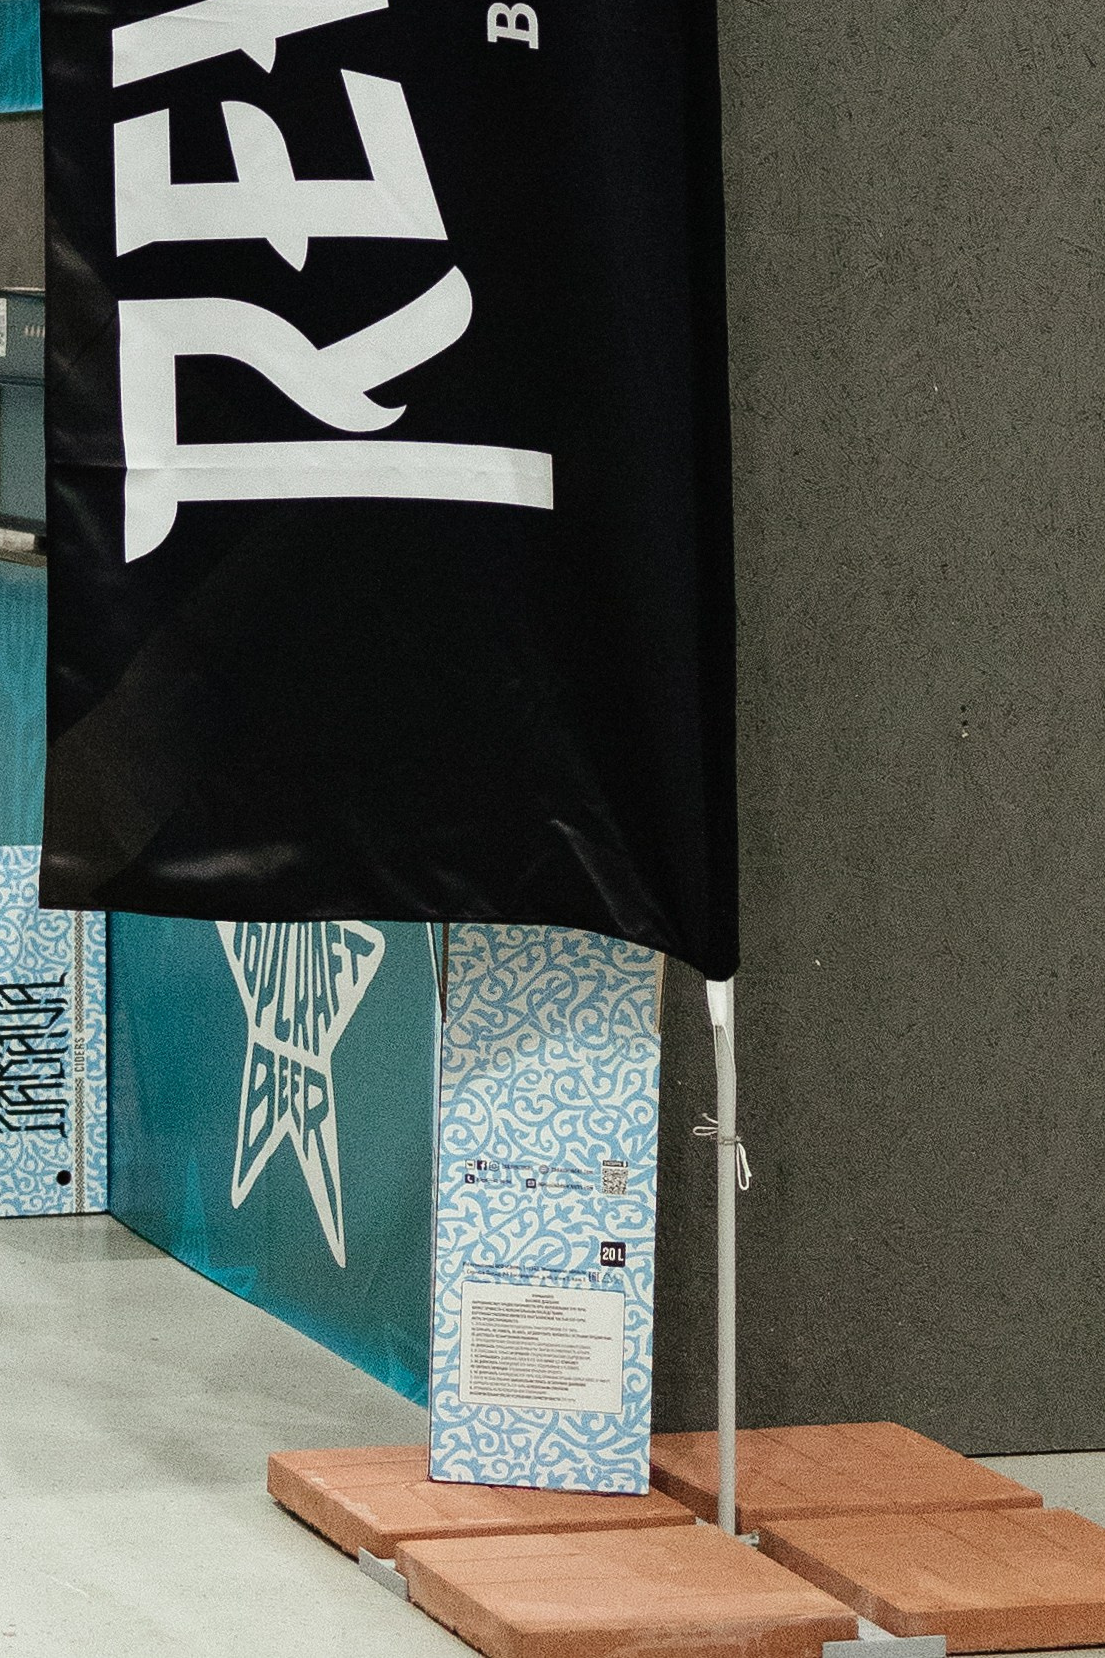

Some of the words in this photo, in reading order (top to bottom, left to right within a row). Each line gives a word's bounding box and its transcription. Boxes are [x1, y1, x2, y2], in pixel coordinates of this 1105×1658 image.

[74, 1036, 86, 1073] CIDERS
[237, 1041, 340, 1242] BEER
[602, 1246, 616, 1262] 20
[617, 1248, 624, 1262] L
